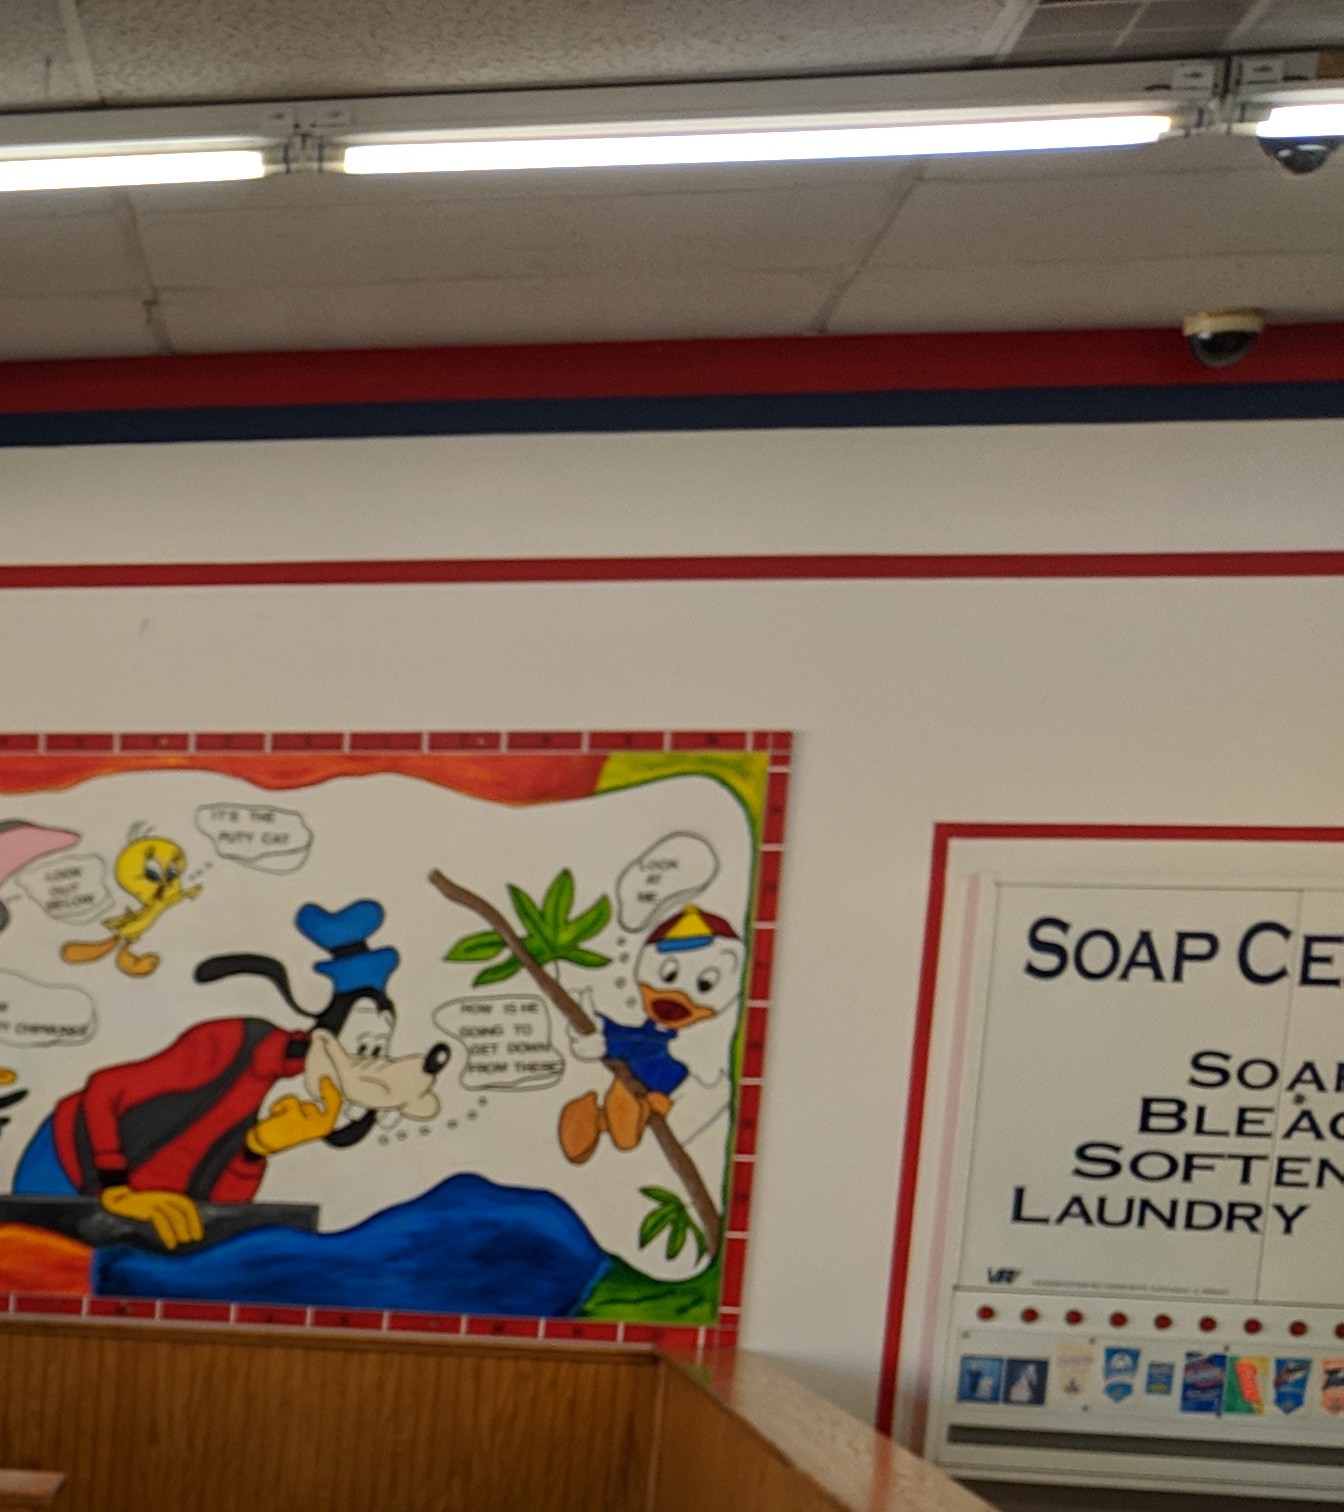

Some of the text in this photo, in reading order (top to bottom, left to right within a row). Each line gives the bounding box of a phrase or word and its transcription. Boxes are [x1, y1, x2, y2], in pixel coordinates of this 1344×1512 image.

[1024, 915, 1344, 988] SOAP CE
[1010, 1185, 1310, 1236] LAUNDRY
